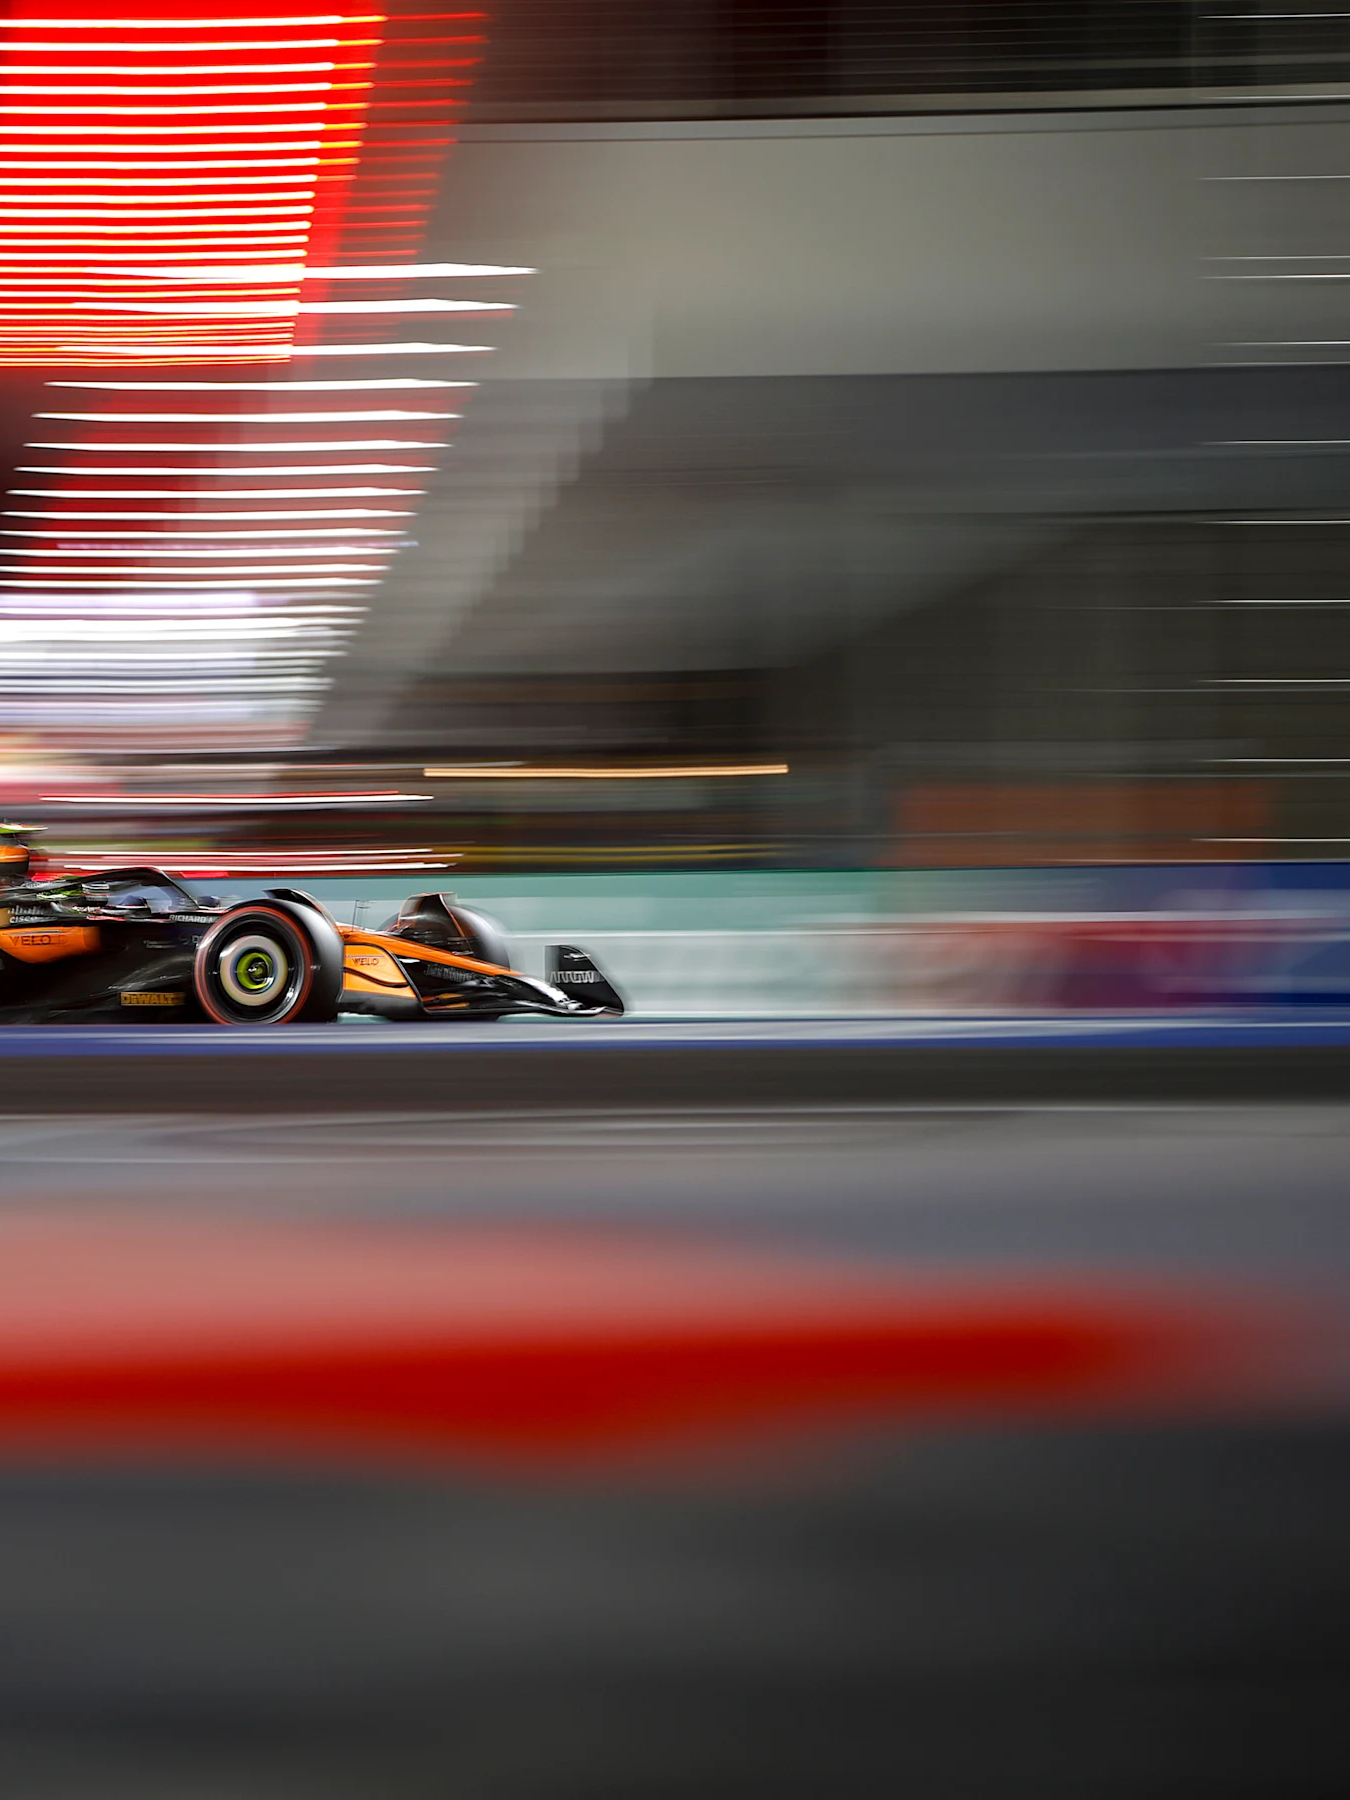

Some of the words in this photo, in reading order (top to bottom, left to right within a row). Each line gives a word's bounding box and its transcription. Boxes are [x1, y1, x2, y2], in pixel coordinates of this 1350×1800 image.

[169, 914, 207, 923] RICHARD
[10, 934, 51, 946] VELO
[353, 957, 379, 966] VELO
[551, 970, 595, 983] ARROW
